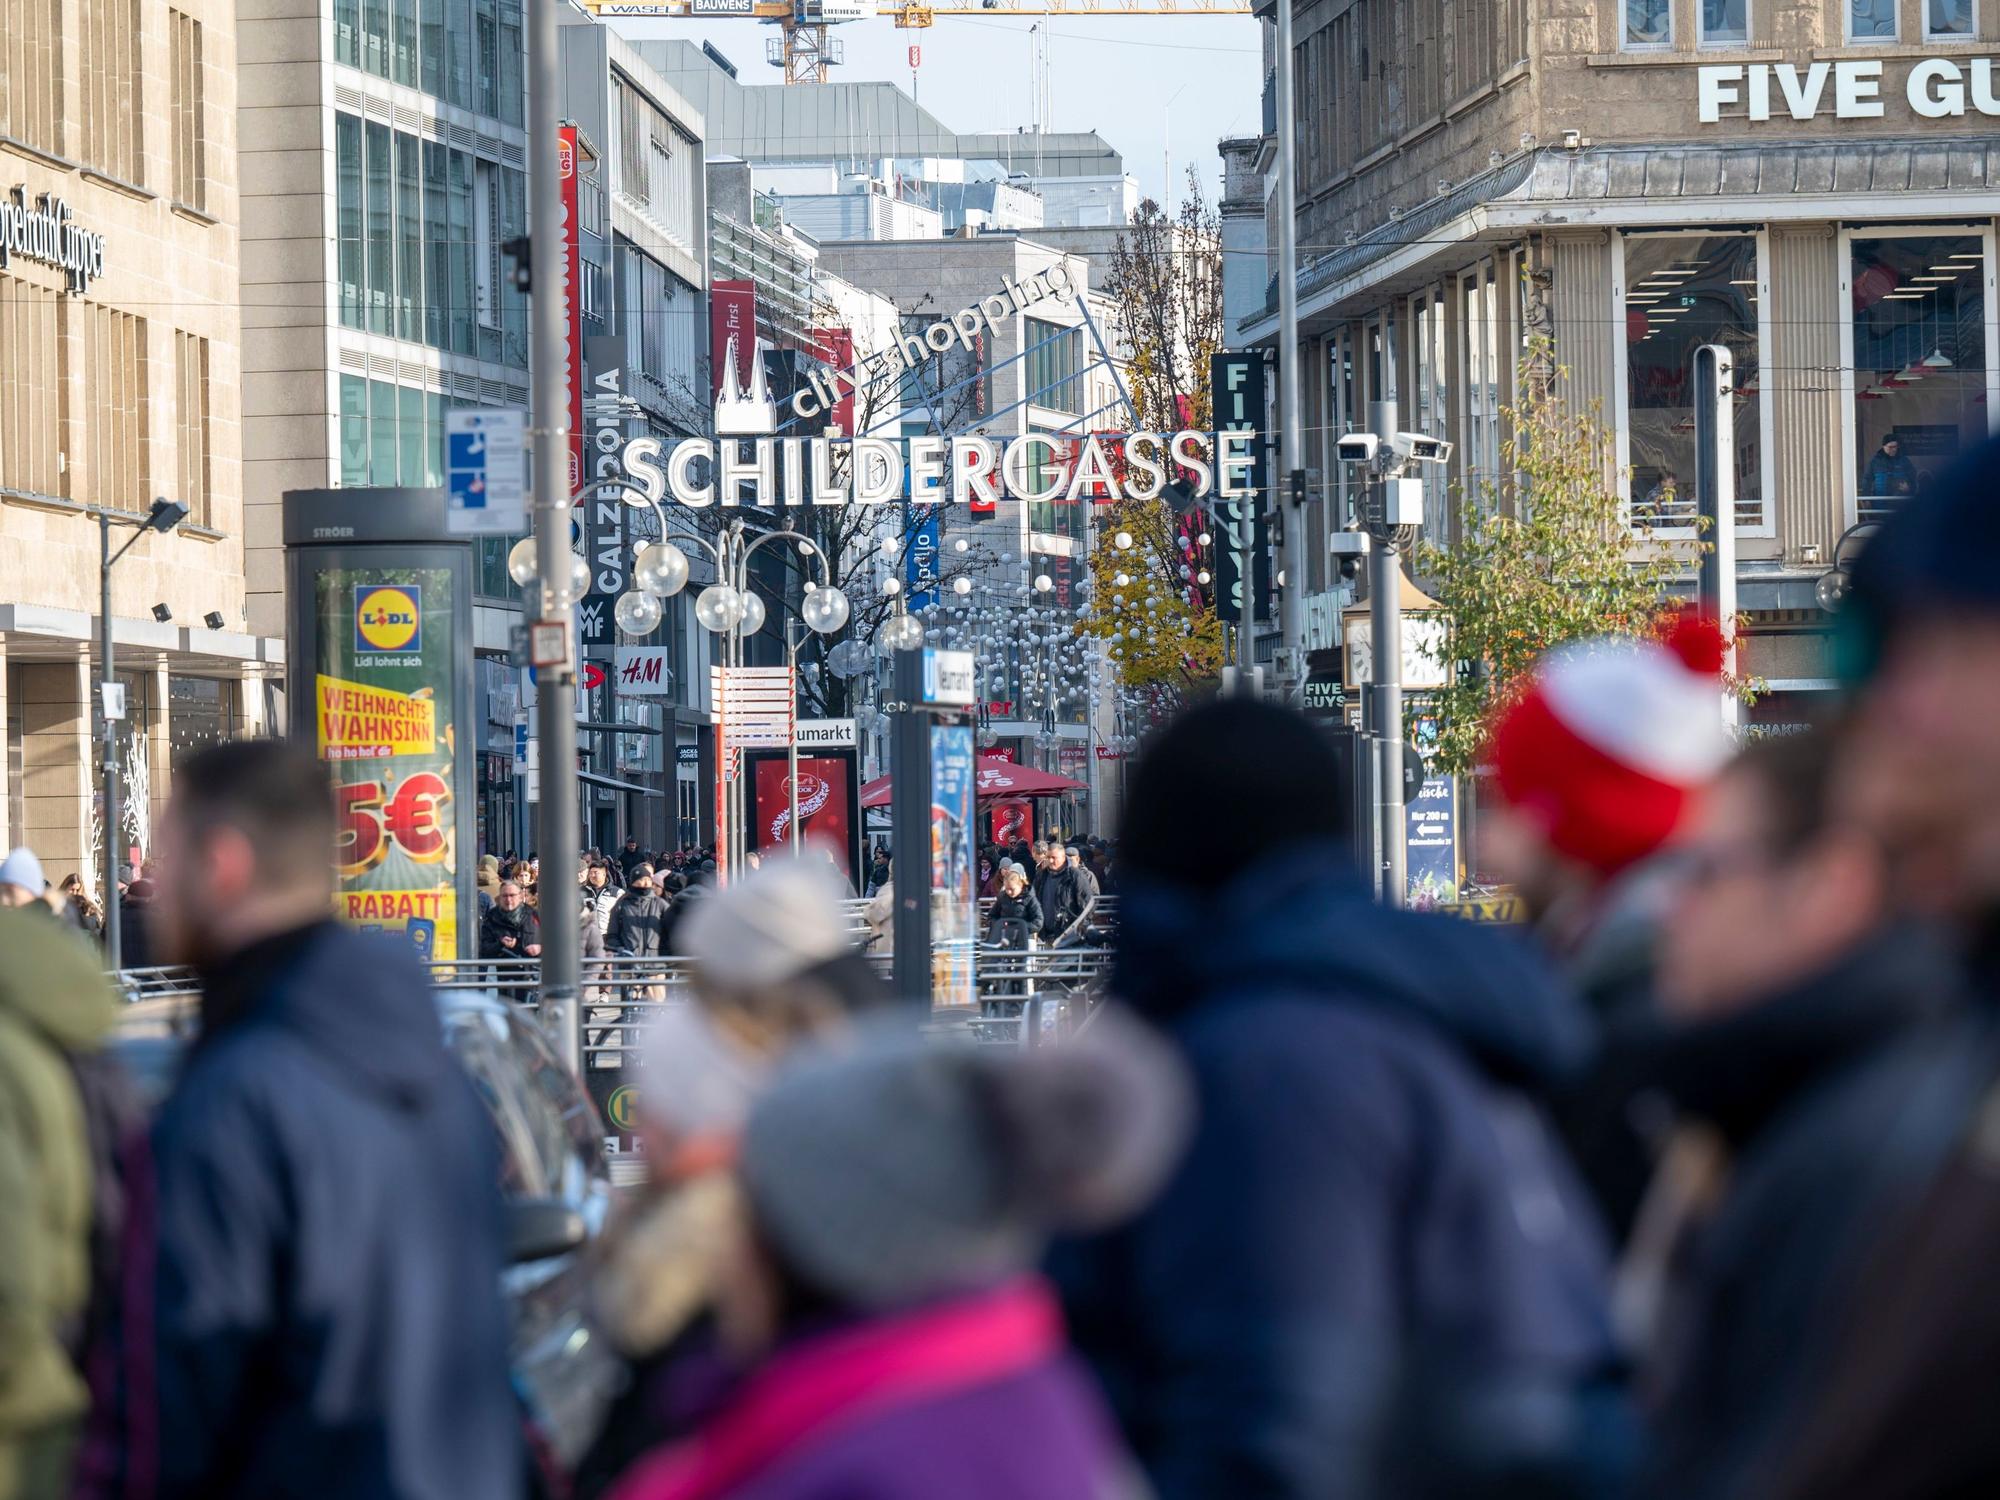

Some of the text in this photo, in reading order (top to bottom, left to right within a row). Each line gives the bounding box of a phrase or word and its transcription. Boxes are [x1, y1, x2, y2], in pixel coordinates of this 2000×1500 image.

[611, 5, 670, 13] WASEL
[695, 0, 750, 10] BAUWENS
[1698, 61, 1884, 122] FIVE
[791, 253, 1080, 419] city shopping
[621, 430, 1257, 508] SCHILDERGASSE
[313, 526, 354, 538] STRÖER
[354, 656, 422, 667] Lidl lohnt sich
[621, 657, 663, 684] H&M
[1305, 683, 1342, 695] FIVE
[323, 686, 431, 720] WEIHNACHTS-
[1303, 696, 1346, 708] GUYS
[323, 712, 431, 742] WAHNSINN
[797, 725, 851, 742] umarkt
[328, 747, 341, 758] ho
[344, 746, 357, 757] ho
[1411, 811, 1449, 821] Nur 200 m
